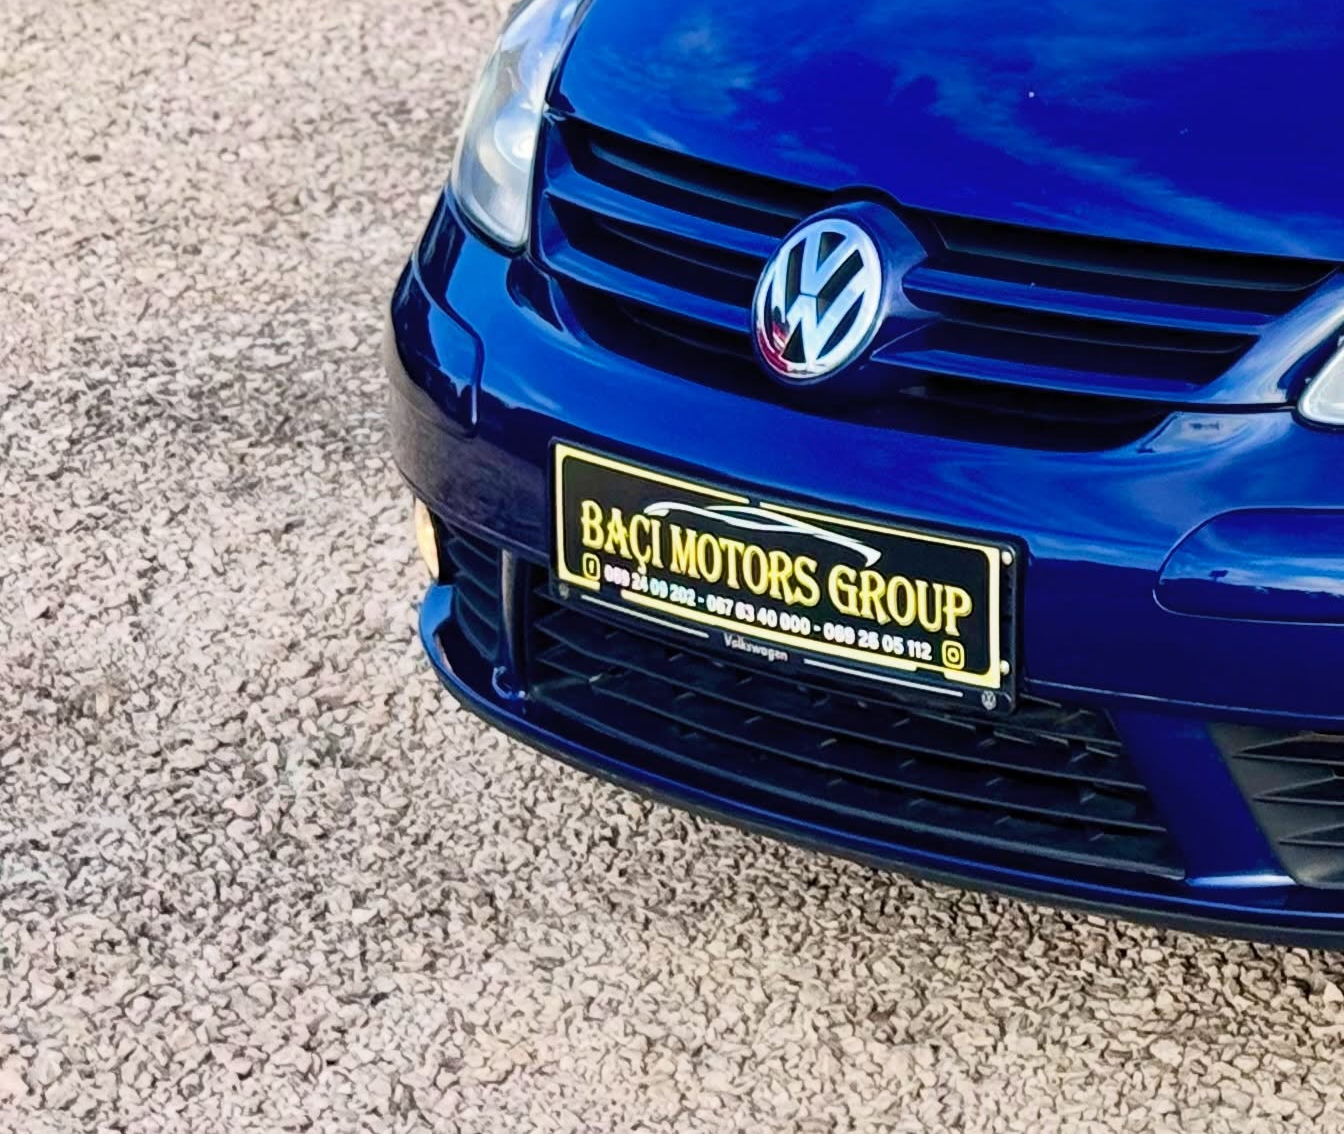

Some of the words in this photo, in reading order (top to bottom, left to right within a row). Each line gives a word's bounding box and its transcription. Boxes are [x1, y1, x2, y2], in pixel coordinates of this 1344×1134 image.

[670, 525, 820, 607] MOTORS
[828, 565, 973, 637] GROUP
[723, 632, 788, 662] Volkswagen
[906, 639, 933, 662] 112
